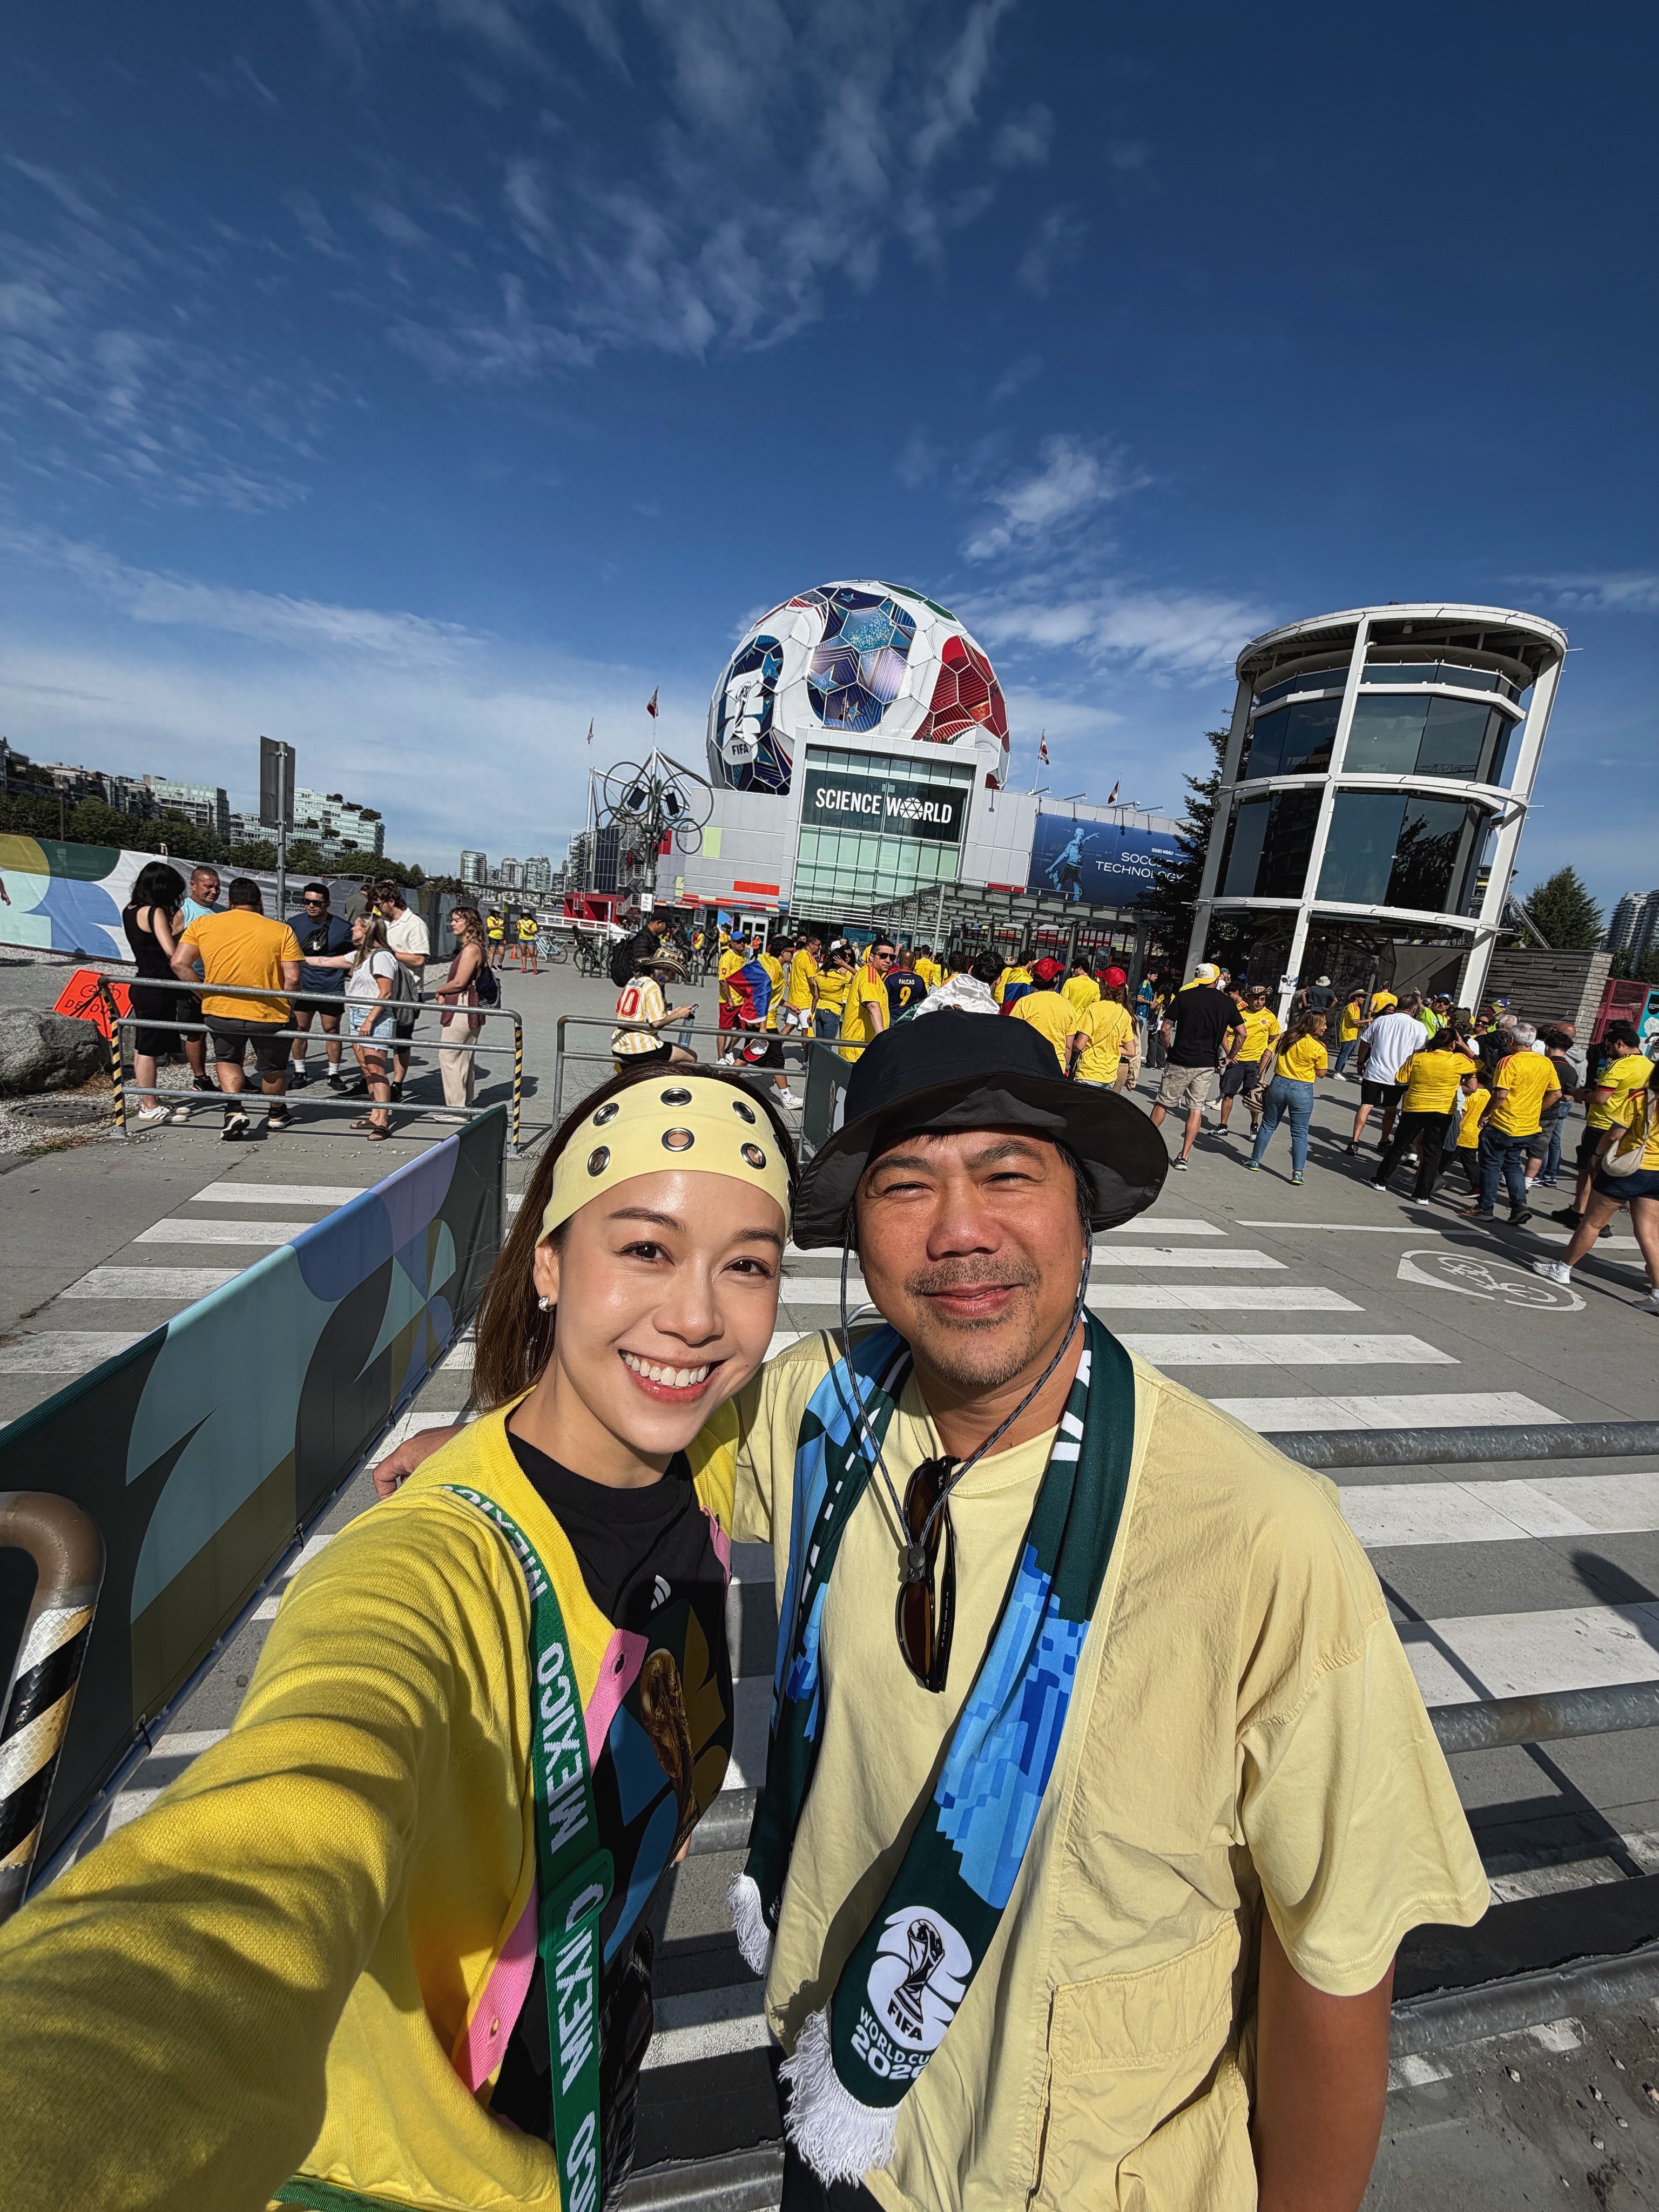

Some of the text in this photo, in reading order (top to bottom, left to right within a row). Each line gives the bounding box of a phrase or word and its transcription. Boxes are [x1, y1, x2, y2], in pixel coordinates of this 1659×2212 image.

[731, 743, 749, 756] FIFA
[815, 788, 952, 824] SCIENCE WORLD
[1121, 852, 1174, 867] SOCC
[899, 986, 911, 1007] 9
[537, 1642, 589, 1854] MEXICO
[556, 1883, 604, 2096] MEXIO
[860, 2006, 930, 2065] WORLD CU
[887, 1998, 923, 2041] FIFA
